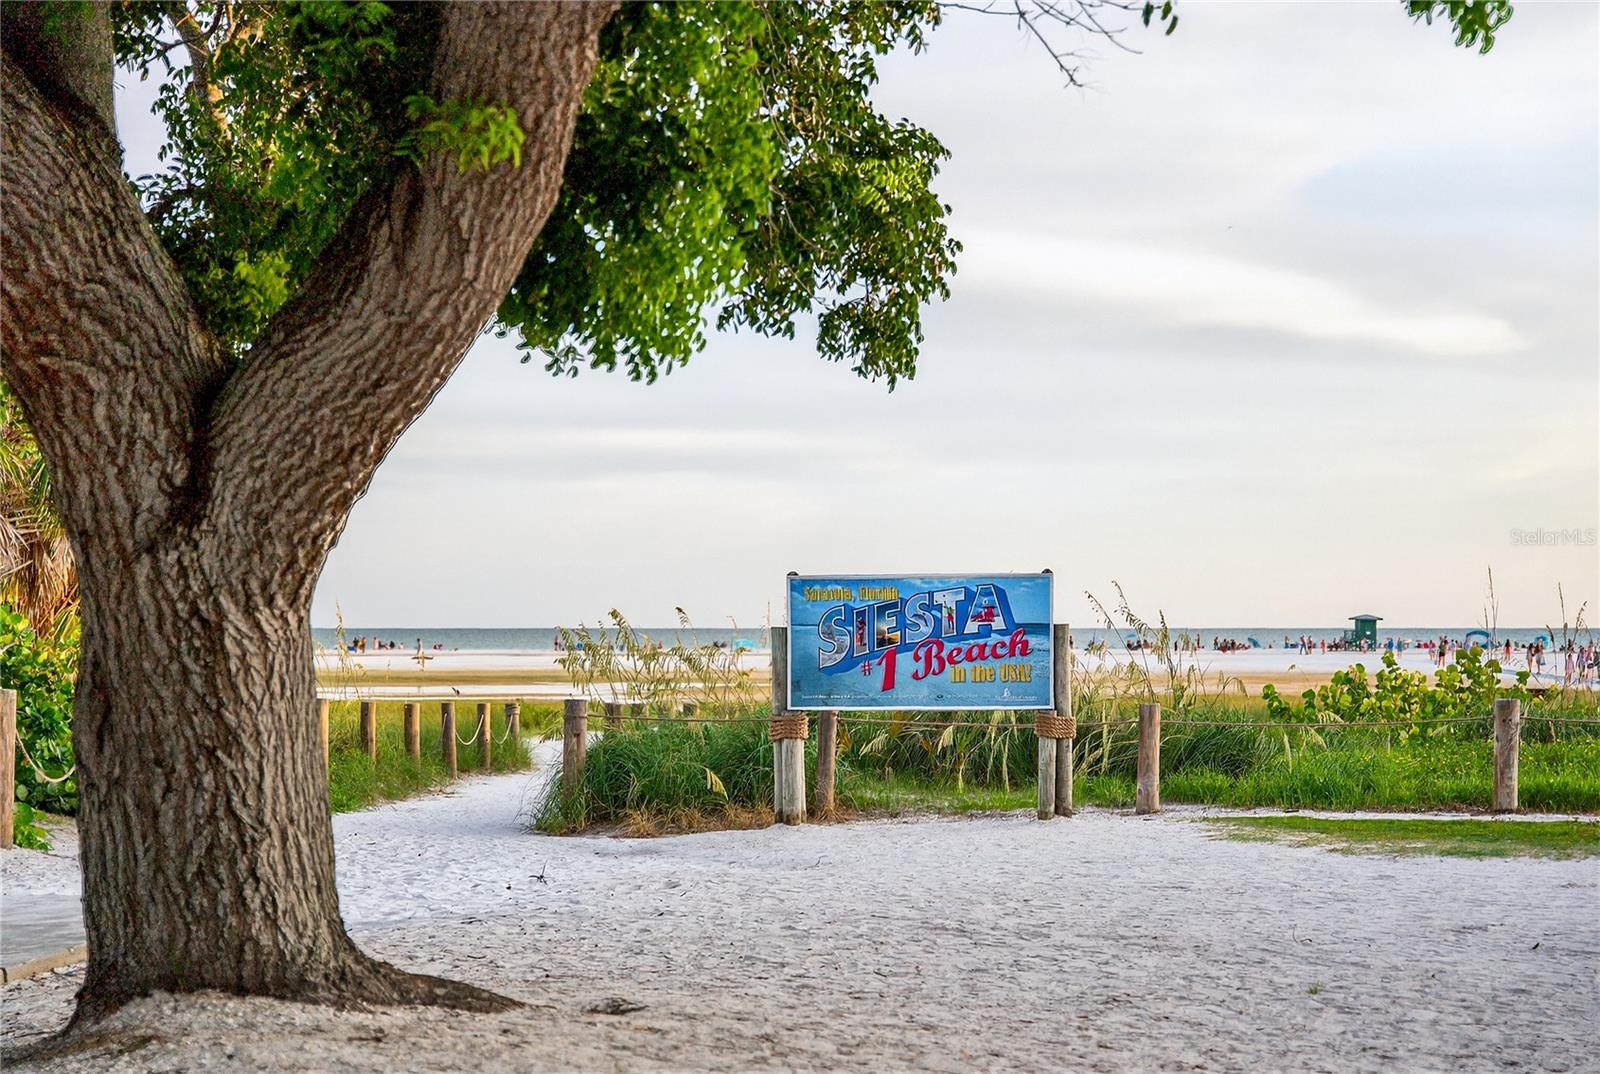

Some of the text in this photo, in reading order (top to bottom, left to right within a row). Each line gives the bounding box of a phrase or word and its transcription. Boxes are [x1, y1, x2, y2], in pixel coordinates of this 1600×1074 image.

[818, 583, 1008, 670] SIESTA
[912, 627, 1034, 680] Beach
[949, 662, 1033, 683] in the USA!
